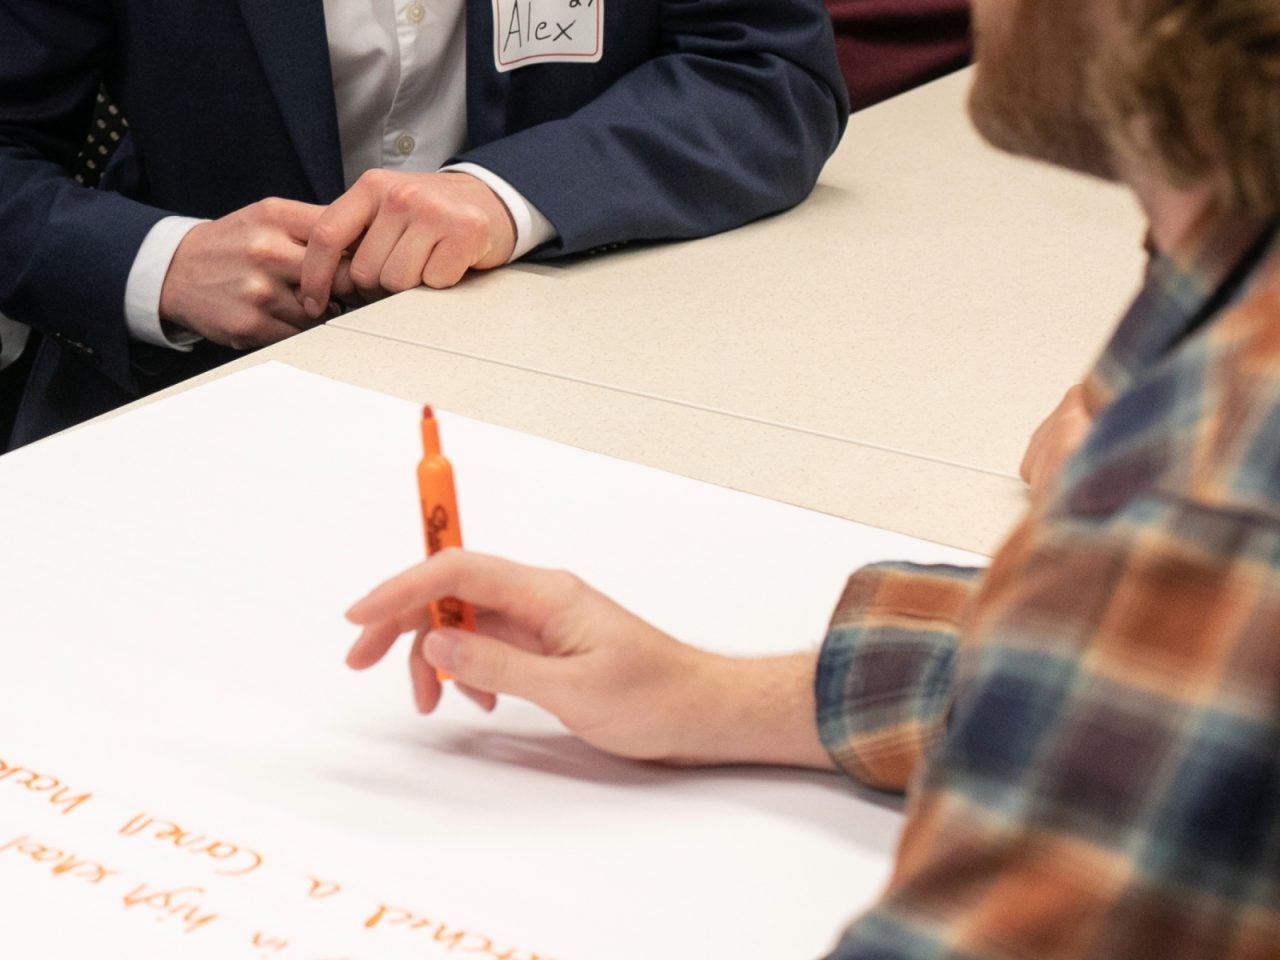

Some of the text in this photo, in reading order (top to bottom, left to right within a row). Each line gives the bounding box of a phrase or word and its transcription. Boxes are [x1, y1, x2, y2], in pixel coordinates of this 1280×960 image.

[503, 0, 577, 53] Alex
[118, 812, 263, 876] Cornell
[122, 883, 219, 933] high
[306, 874, 342, 899] a
